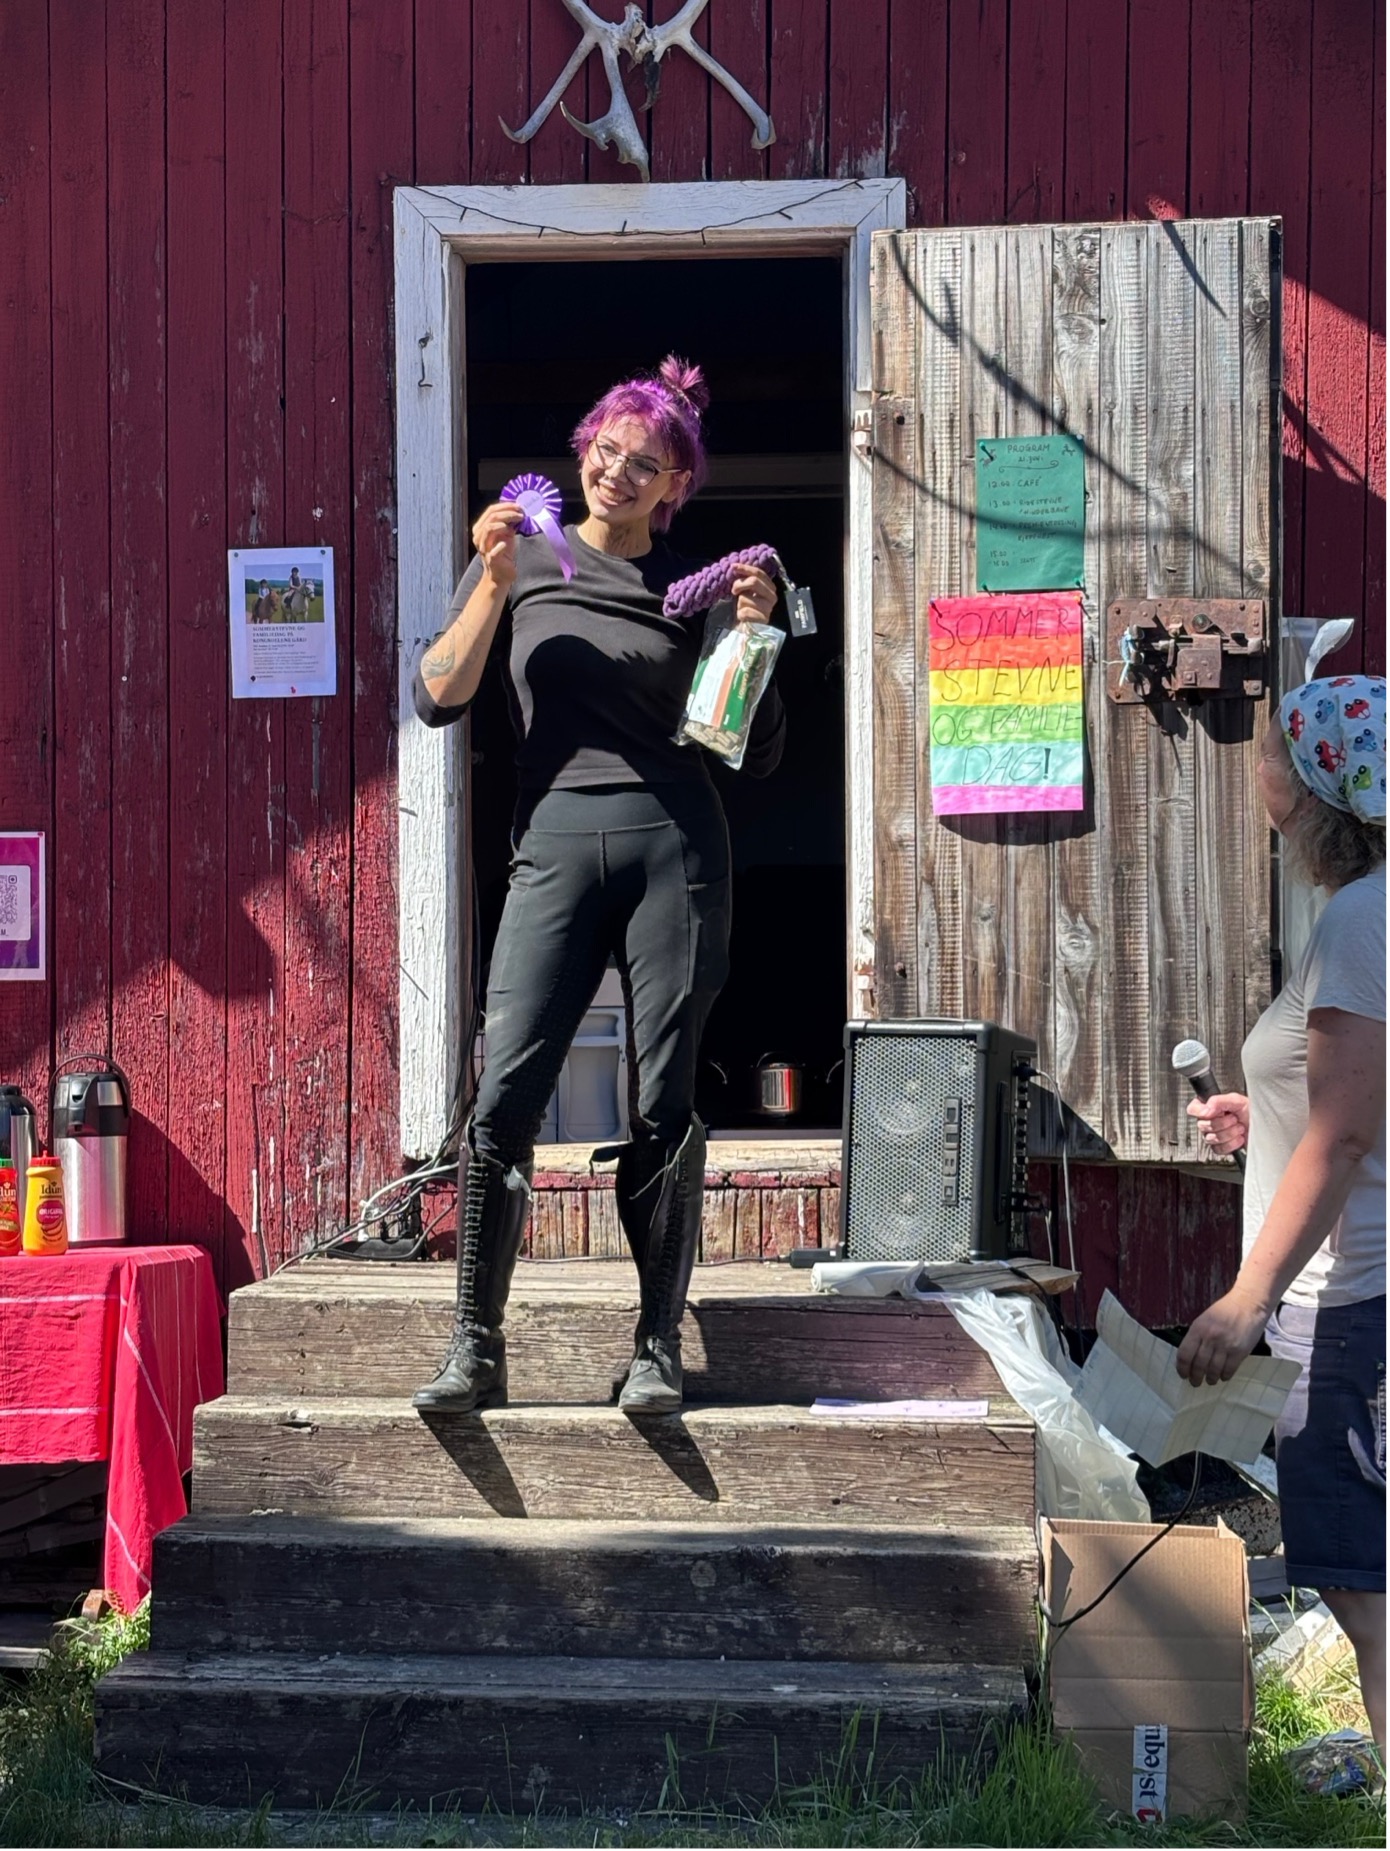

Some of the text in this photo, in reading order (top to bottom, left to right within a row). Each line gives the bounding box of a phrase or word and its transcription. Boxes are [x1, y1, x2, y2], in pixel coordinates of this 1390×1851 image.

[1007, 444, 1050, 453] PROGRAM
[1017, 476, 1042, 487] CAFÉ
[932, 607, 1079, 651] SOMMER-
[941, 653, 1080, 702] STEVNE
[932, 708, 973, 746] OG
[962, 745, 1051, 786] DAG!
[0, 1187, 16, 1196] dun
[41, 1184, 62, 1195] Idun
